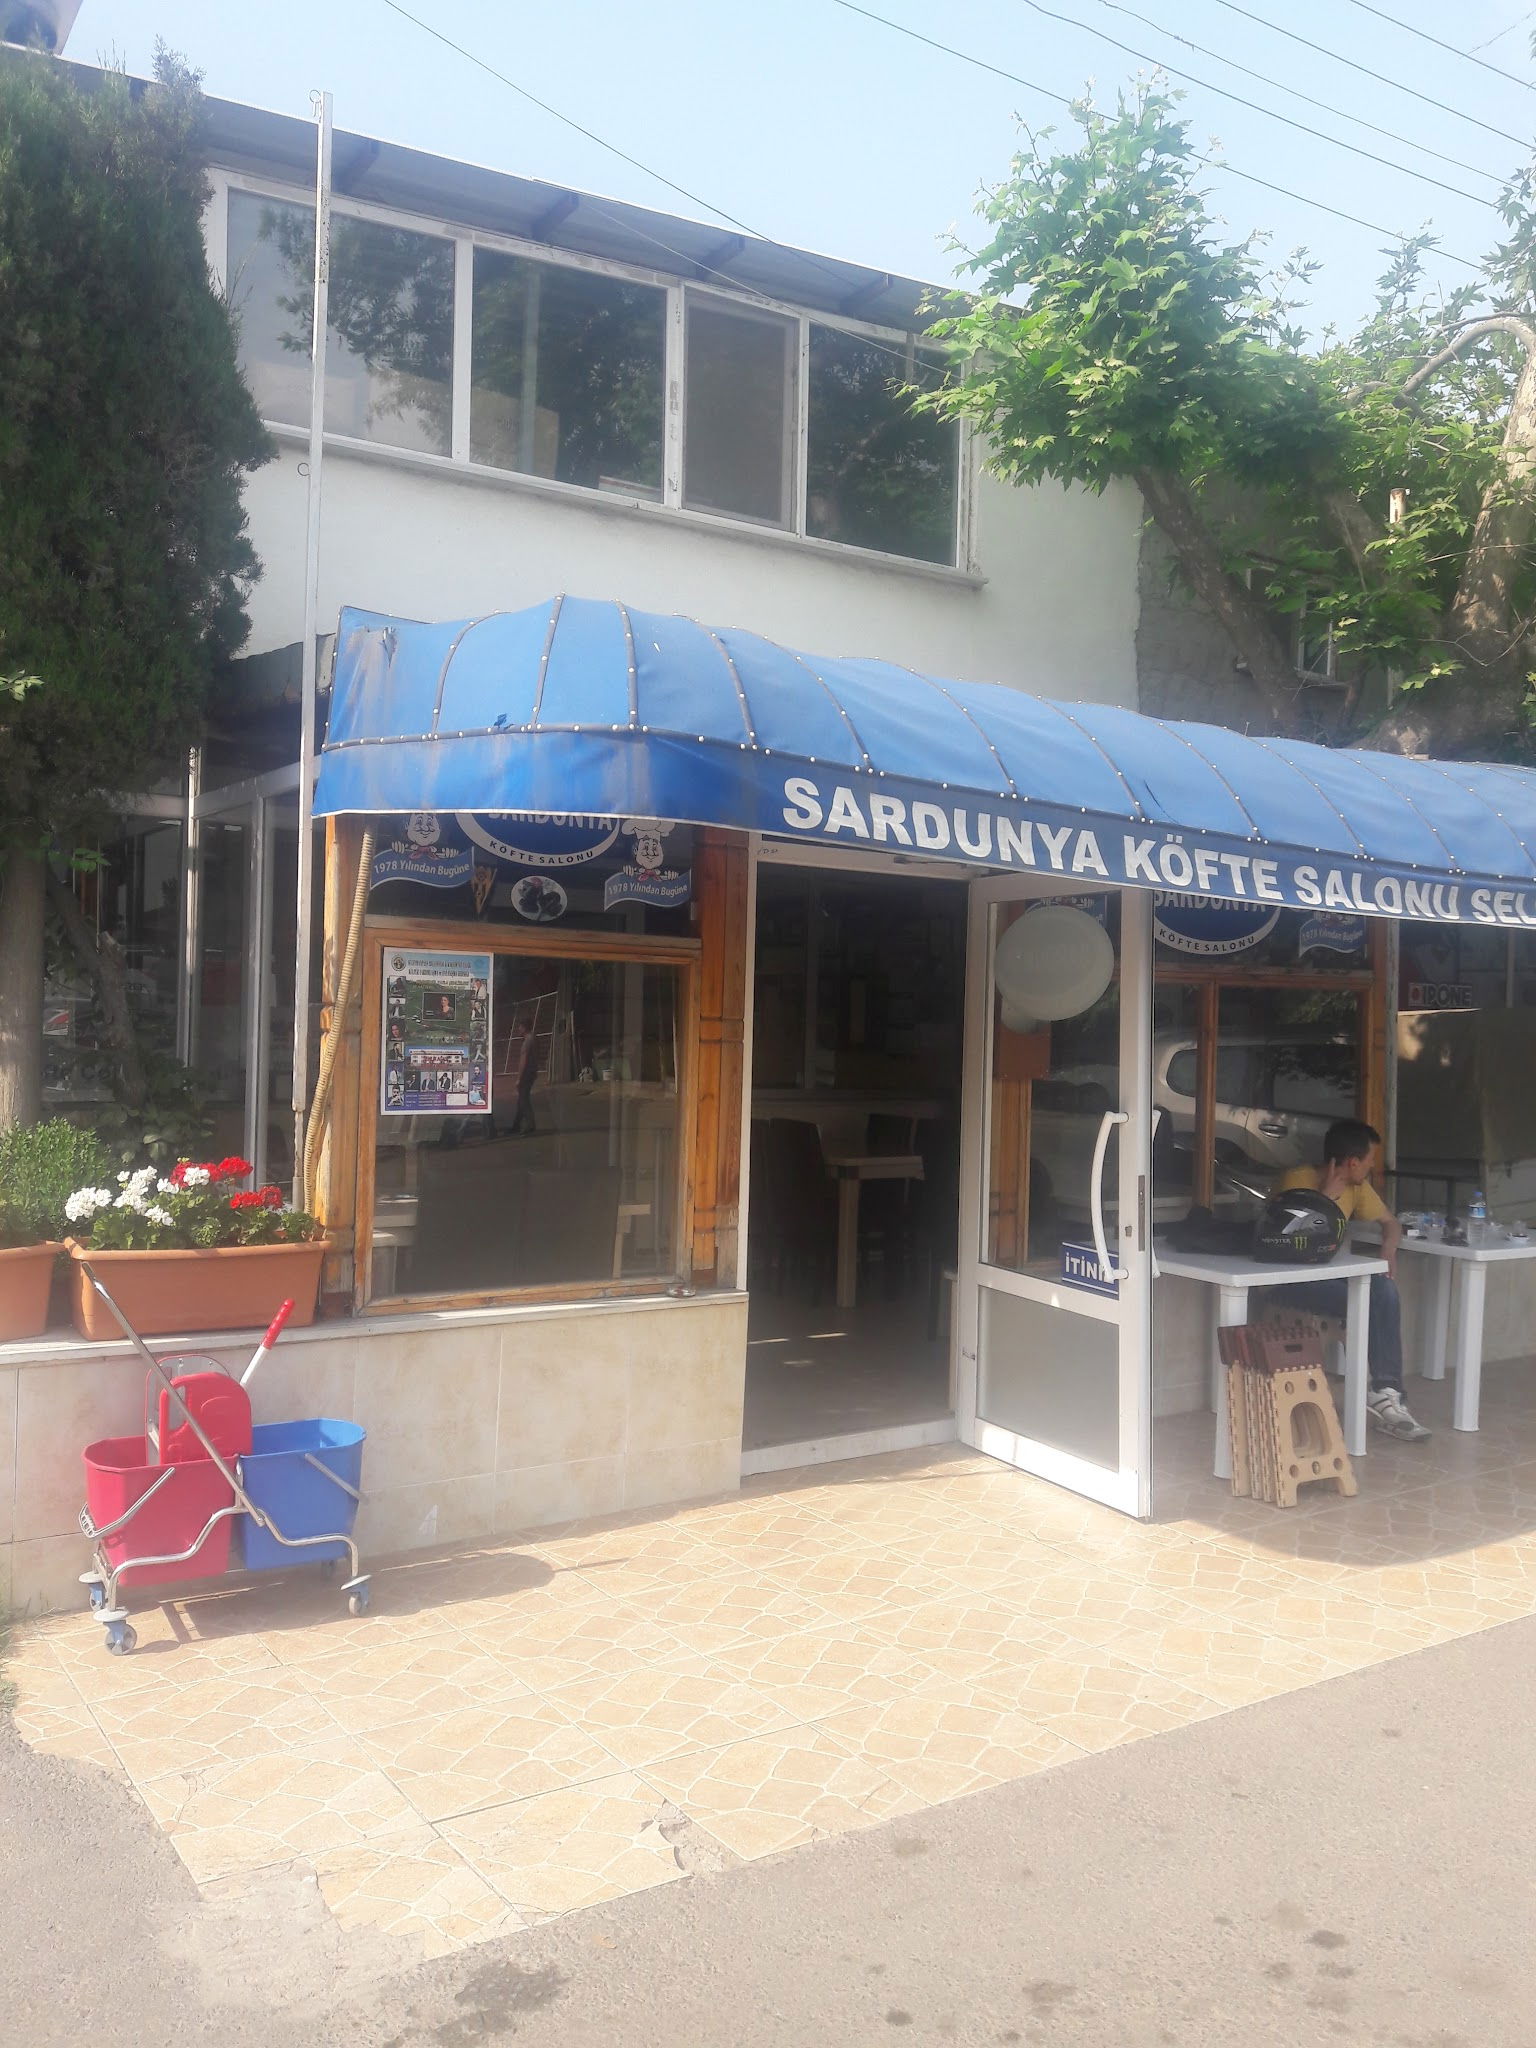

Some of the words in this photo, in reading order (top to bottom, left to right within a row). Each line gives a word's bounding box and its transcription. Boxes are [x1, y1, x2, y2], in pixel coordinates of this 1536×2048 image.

[489, 840, 534, 863] KÖFTE
[539, 850, 594, 864] SALONU
[782, 777, 1110, 876] SARDUNYA
[1123, 833, 1284, 901] KÖFTE
[1293, 865, 1461, 920] SALONU
[1471, 888, 1536, 925] SEL
[374, 860, 398, 874] 1978
[400, 859, 436, 875] Yılından
[437, 863, 470, 878] Bugüne
[608, 882, 628, 895] 1978
[1159, 928, 1200, 951] KÖFTE
[1203, 936, 1255, 952] SALONU
